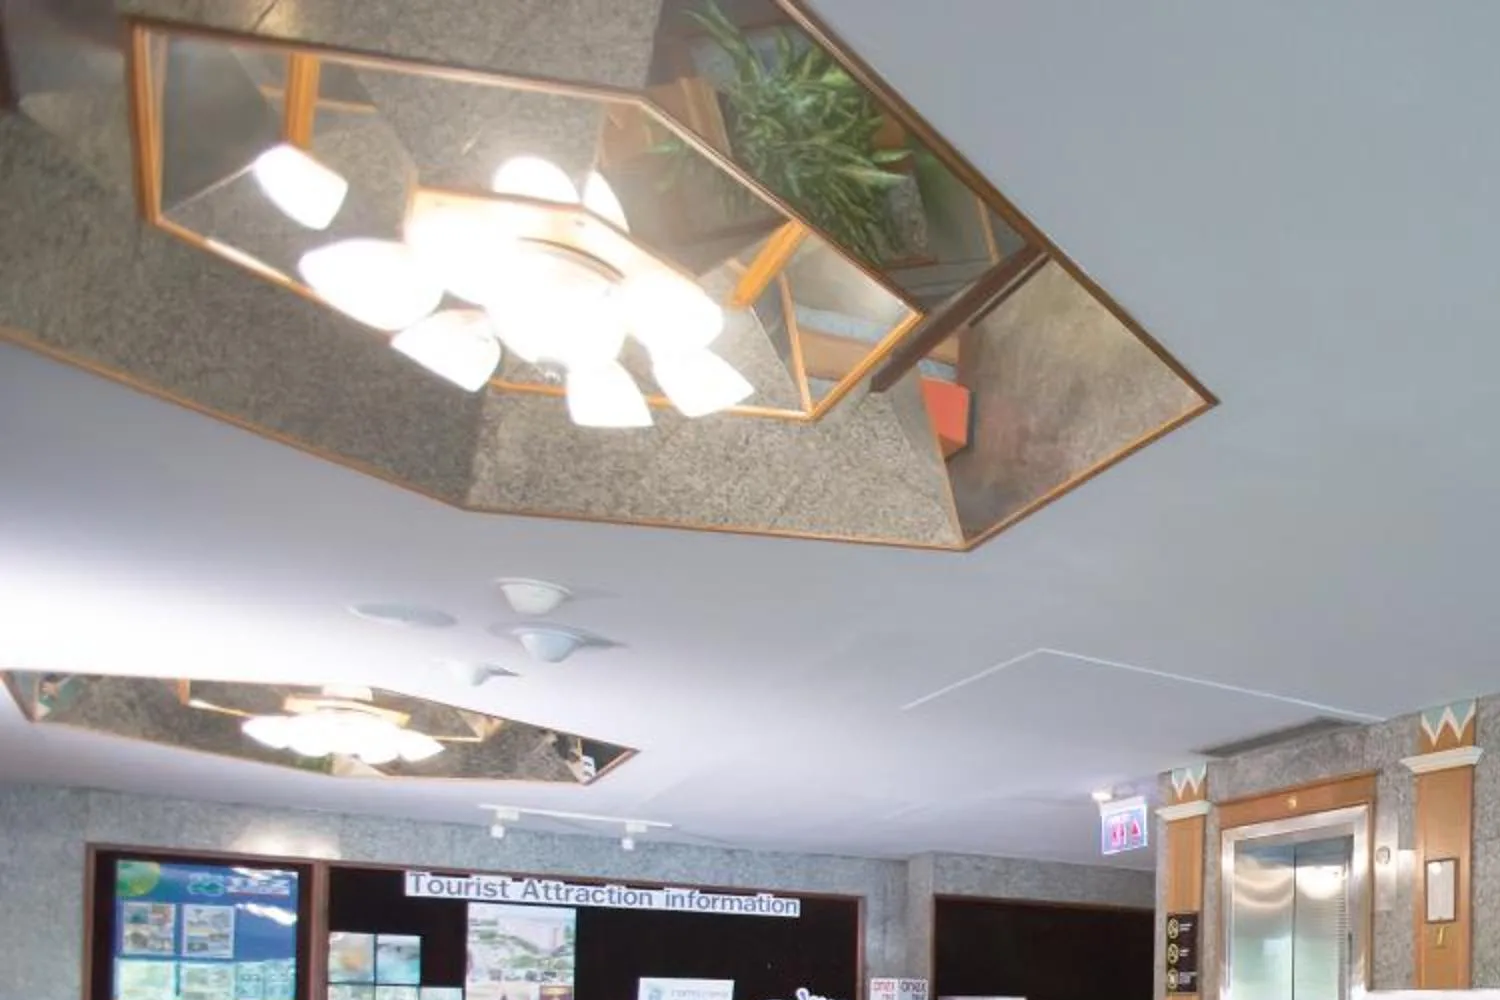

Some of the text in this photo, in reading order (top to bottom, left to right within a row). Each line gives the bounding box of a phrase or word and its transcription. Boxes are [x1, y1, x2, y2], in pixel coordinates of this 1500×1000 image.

[410, 873, 797, 914] Tourist Attraction information
